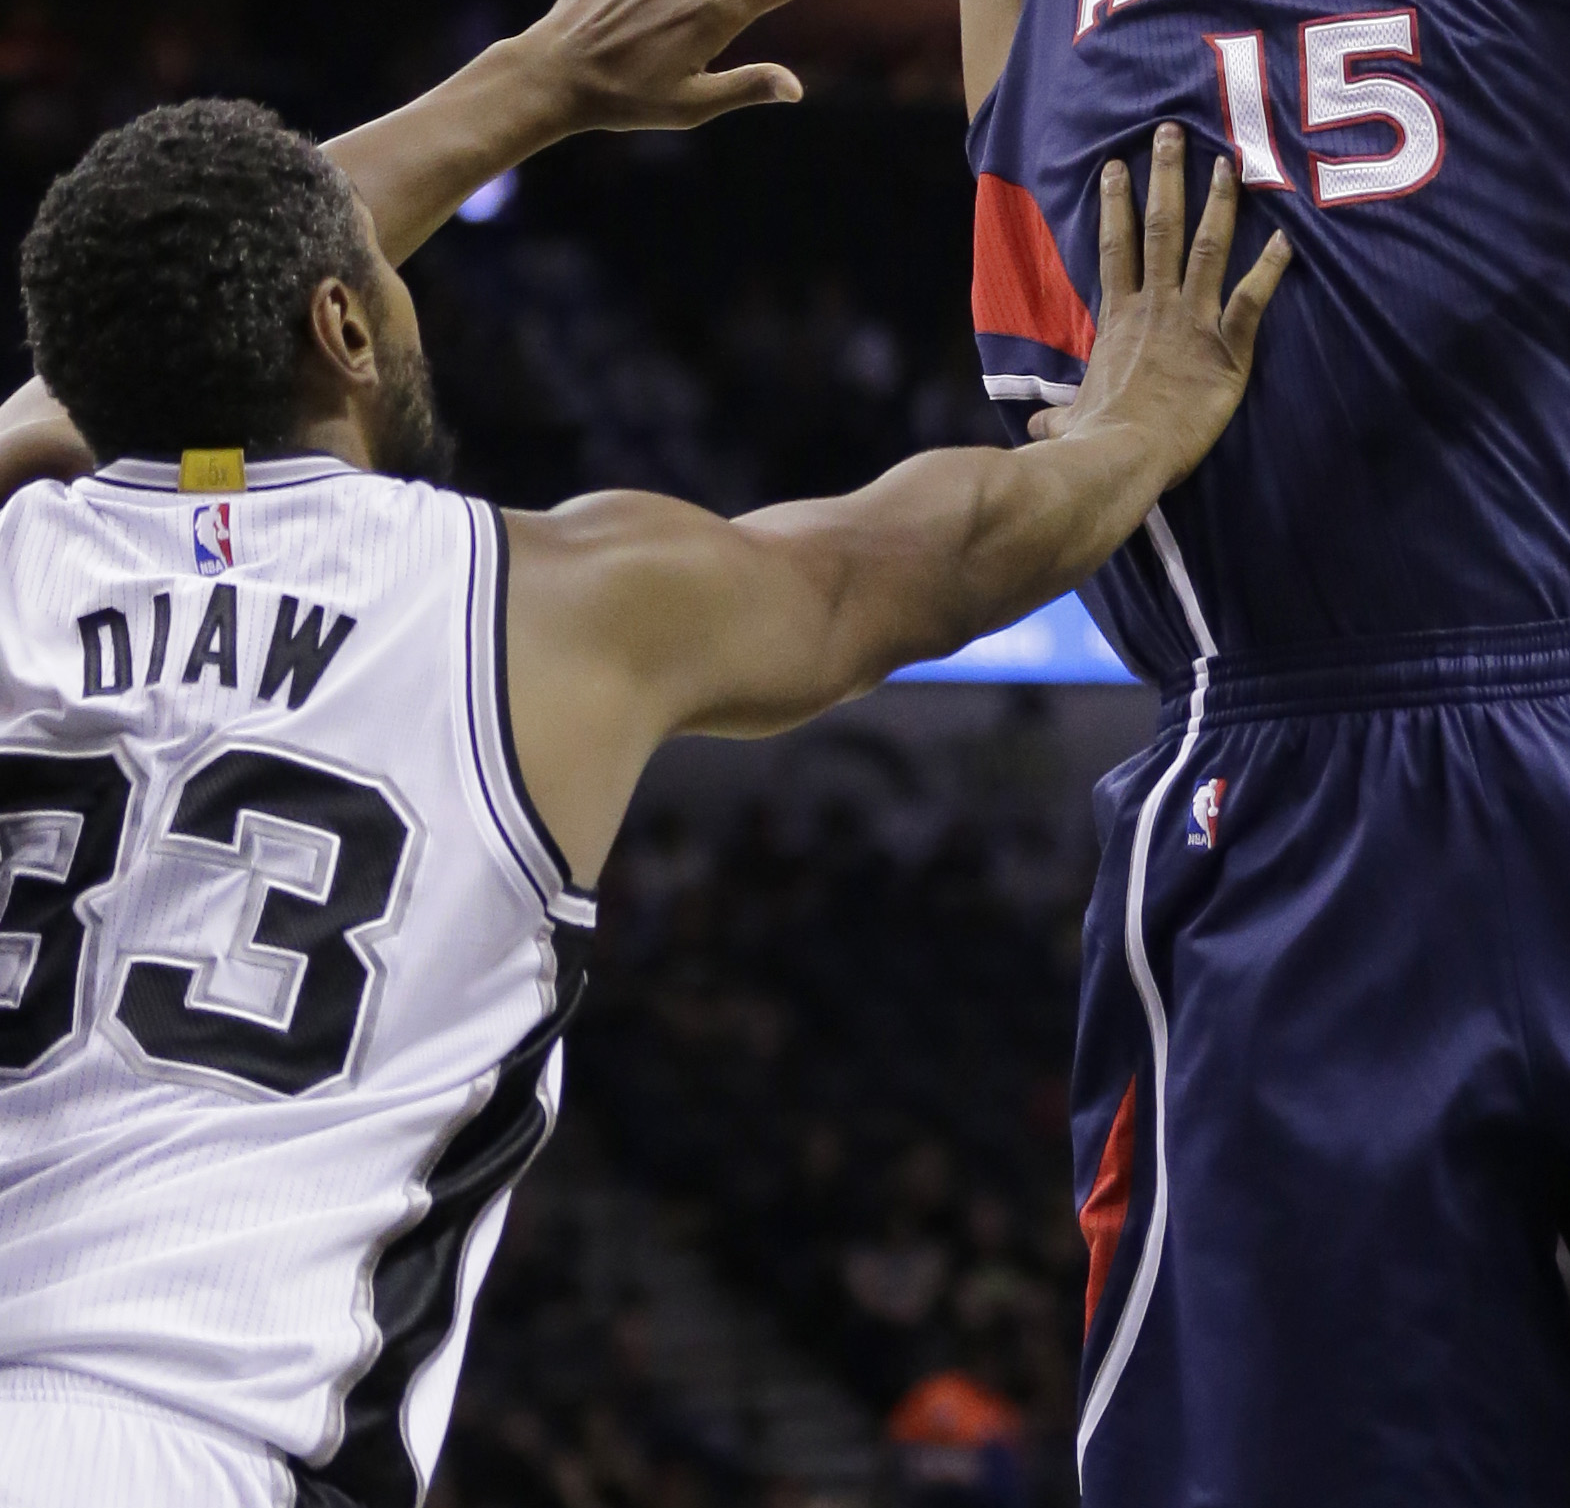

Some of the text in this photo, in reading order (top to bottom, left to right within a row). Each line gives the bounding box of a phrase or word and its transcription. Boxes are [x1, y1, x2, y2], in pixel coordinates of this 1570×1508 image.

[1203, 7, 1445, 209] 15
[78, 583, 357, 711] DIAW
[1187, 833, 1208, 846] NBA
